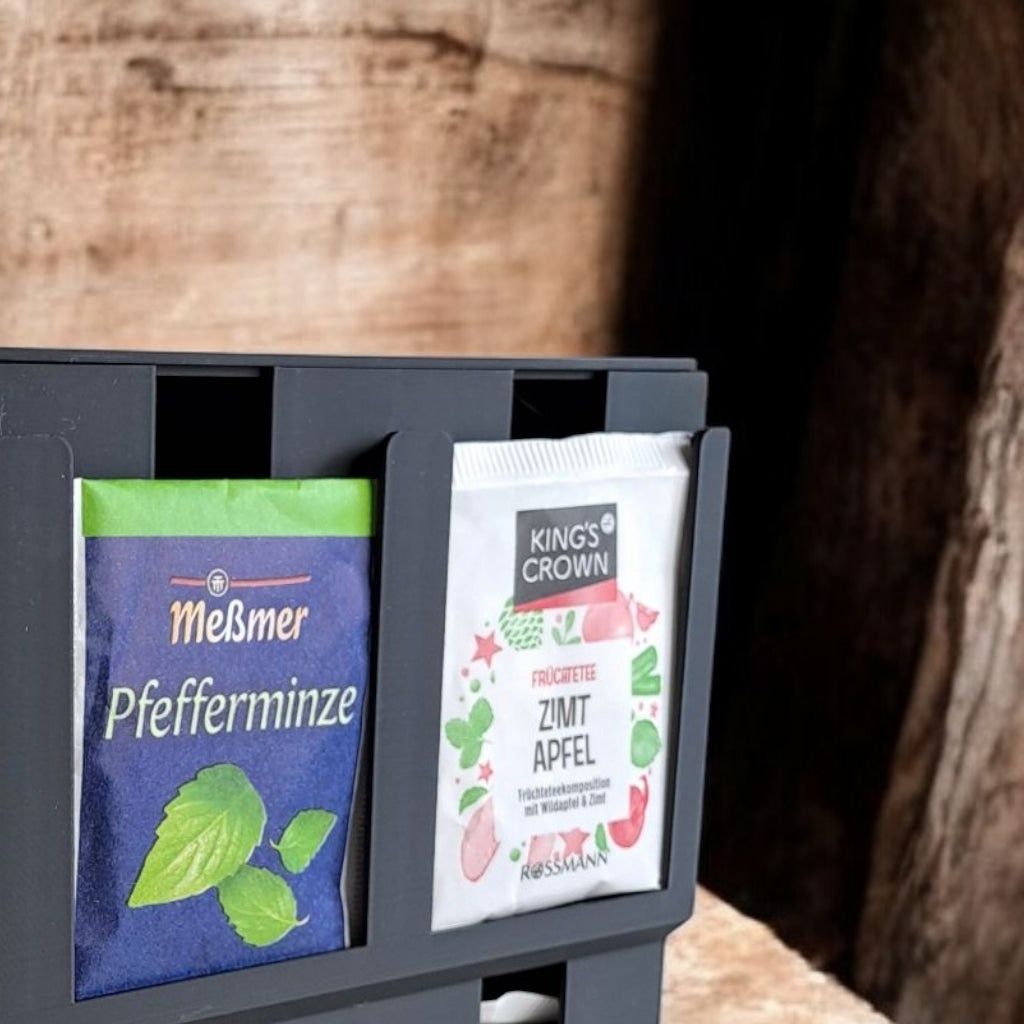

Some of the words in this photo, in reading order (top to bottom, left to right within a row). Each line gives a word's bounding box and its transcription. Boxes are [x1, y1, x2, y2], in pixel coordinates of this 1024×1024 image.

[530, 521, 600, 554] KING'S
[522, 552, 609, 583] CROWN
[169, 599, 310, 645] Meßmer
[531, 662, 597, 689] FRÜCHTETEE
[104, 676, 358, 740] Pfefferminze
[538, 694, 591, 732] ZIMT
[533, 734, 596, 774] APFEL
[517, 777, 611, 802] Früchteteekomposition
[524, 803, 539, 817] mit
[540, 796, 580, 815] Wildapfel
[581, 794, 588, 808] &
[588, 791, 607, 807] Zimt
[520, 851, 609, 882] ROSSMANN
